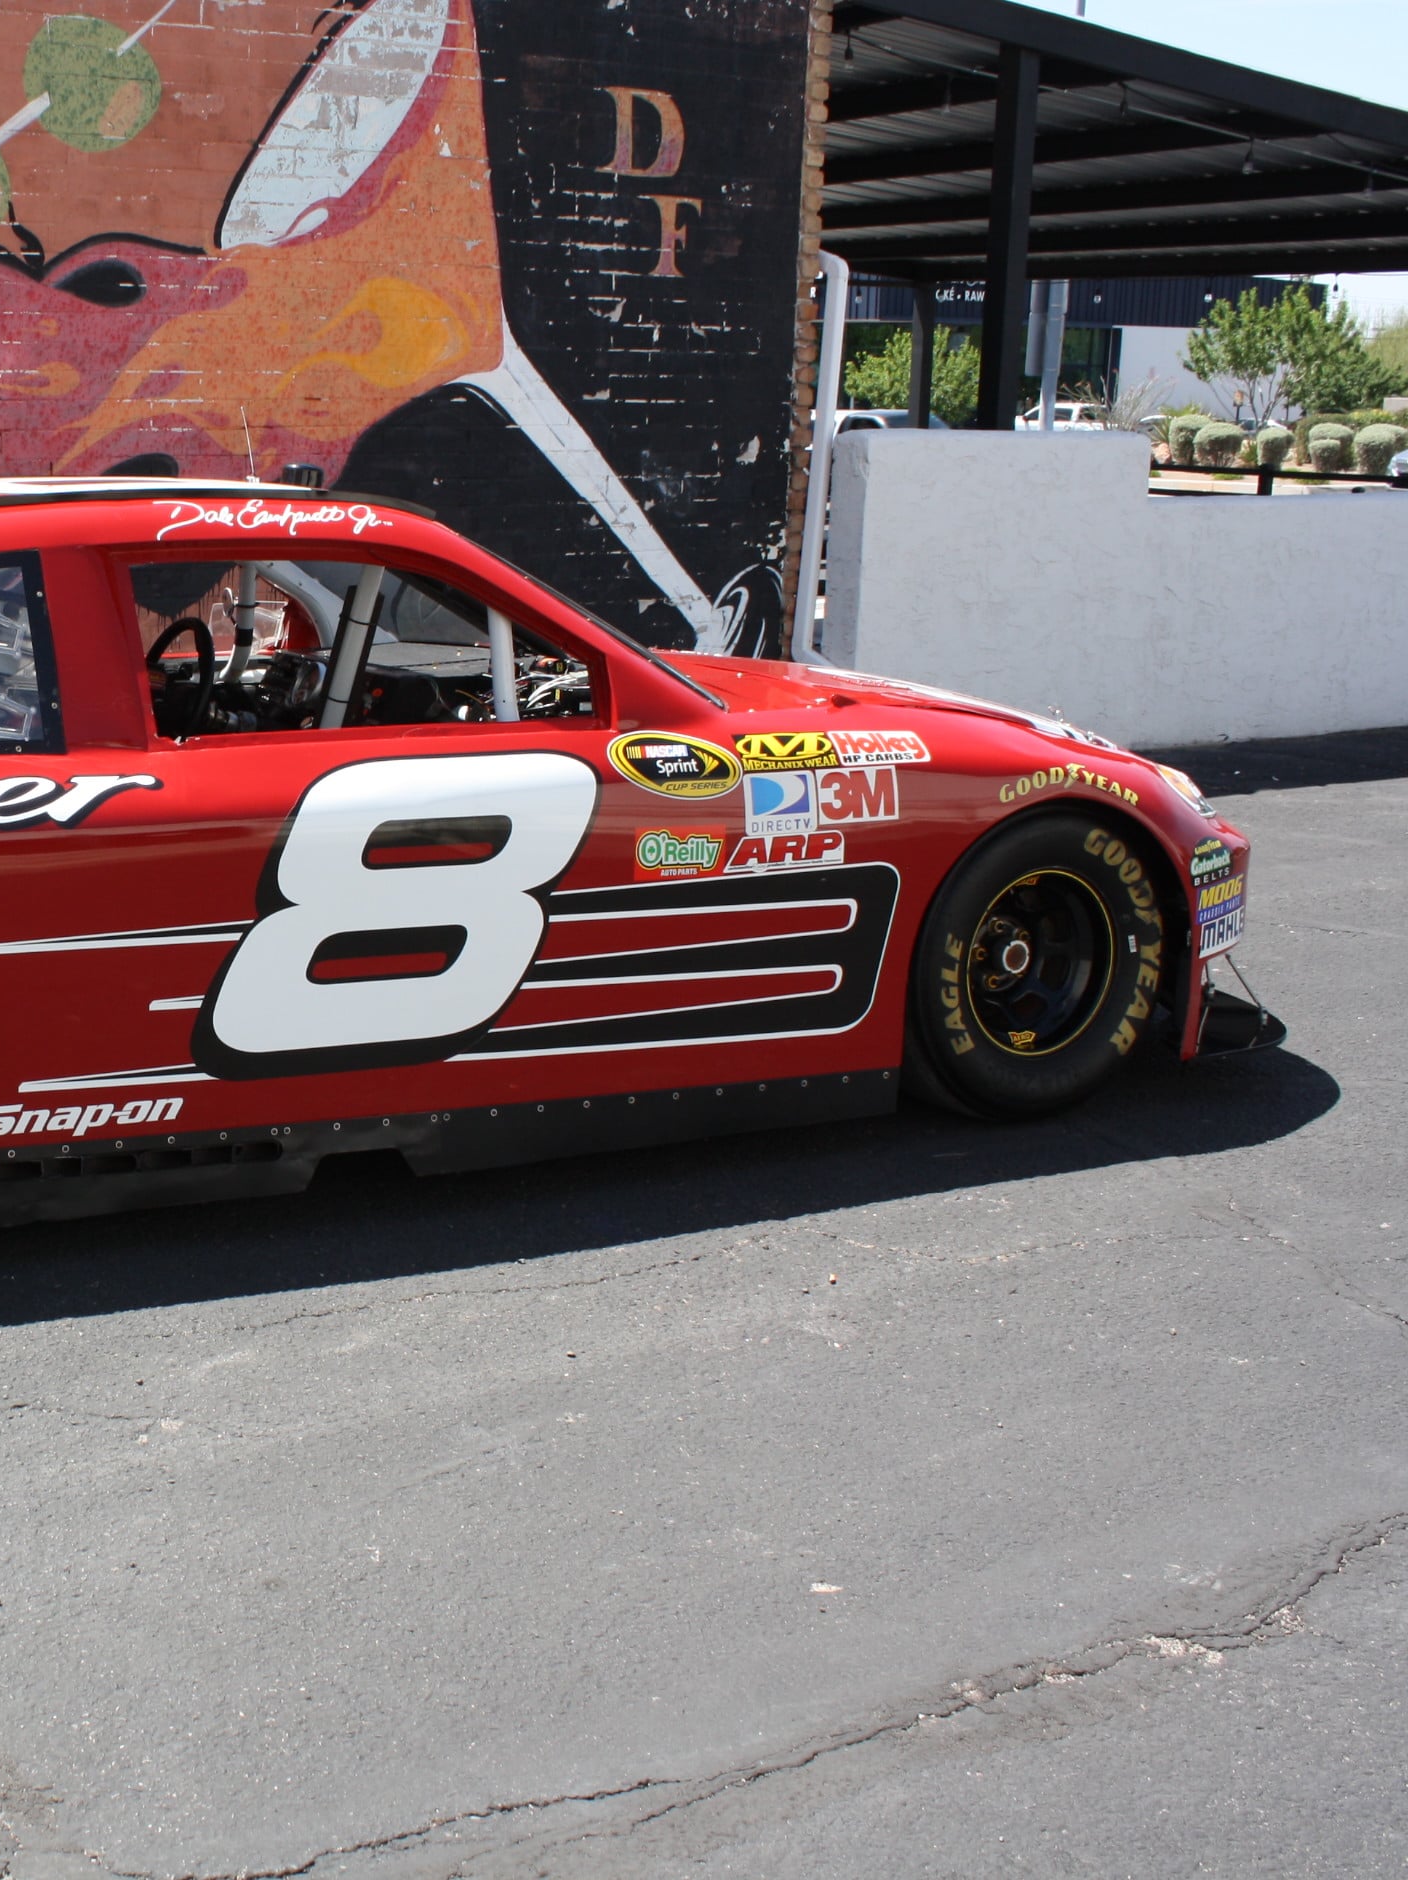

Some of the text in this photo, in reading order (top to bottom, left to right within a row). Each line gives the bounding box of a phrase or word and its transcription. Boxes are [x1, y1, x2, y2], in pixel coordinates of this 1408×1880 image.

[595, 86, 685, 177] D
[648, 195, 702, 277] F
[964, 289, 985, 302] RAW
[152, 500, 234, 541] Dale
[645, 744, 689, 759] NASCAR
[836, 732, 923, 759] Holley
[843, 752, 914, 764] HP CARBS
[656, 758, 699, 778] Sprint
[742, 754, 839, 771] MECHANIX WEAR
[665, 781, 728, 791] CUP SERIES
[820, 768, 896, 821] 3M
[751, 817, 811, 833] DIRECTV
[640, 833, 718, 867] O'Reilly
[729, 832, 842, 867] ARP
[1190, 849, 1231, 876] Gatorback
[660, 868, 698, 877] AUTO PARTS
[1193, 866, 1230, 887] BELTS
[207, 752, 598, 1052] 8
[1198, 873, 1244, 910] MOOG
[941, 932, 976, 1056] EAGLE
